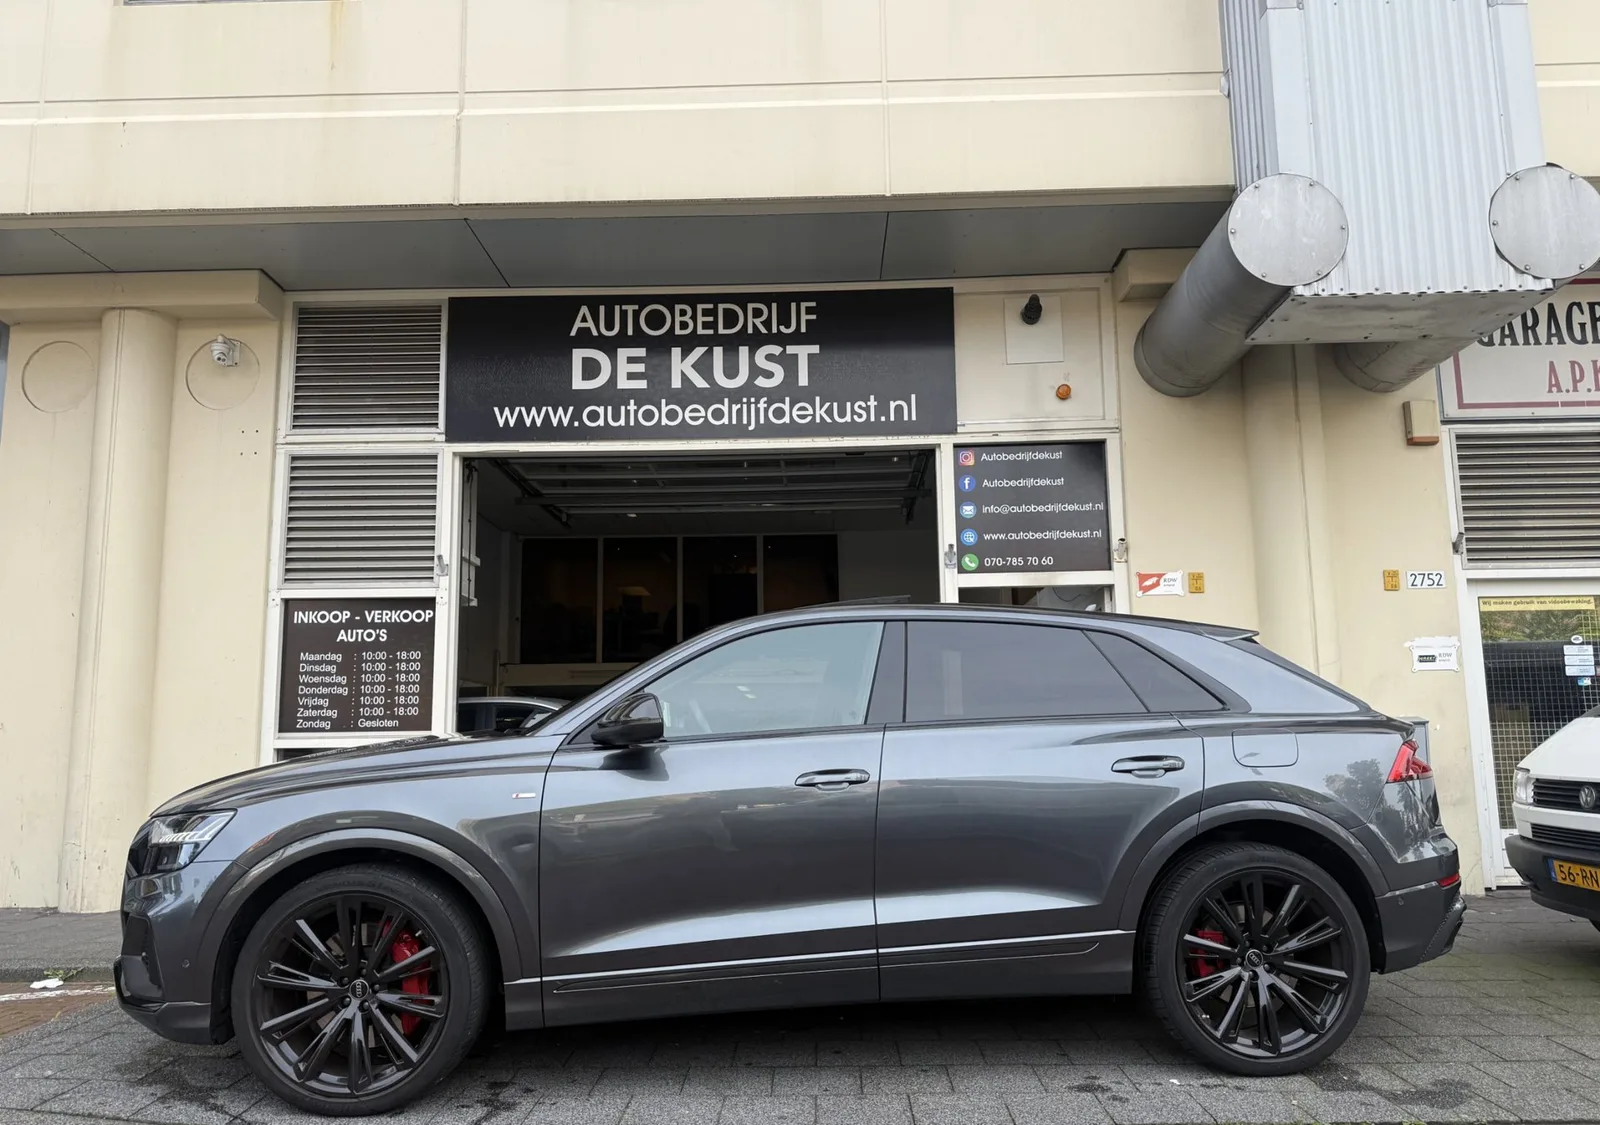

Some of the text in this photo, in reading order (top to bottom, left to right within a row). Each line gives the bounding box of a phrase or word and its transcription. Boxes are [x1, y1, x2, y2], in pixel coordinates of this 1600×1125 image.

[570, 302, 816, 336] AUTOBEDRIJF
[572, 345, 819, 389] DE KUST
[494, 394, 916, 430] www.autobedrijfdekust.nl
[981, 451, 1062, 461] Autobedrijfdekust
[982, 477, 1064, 488] Autobedrijfdekust
[983, 502, 1103, 514] info@autobedrijfdekust.nl
[983, 529, 1101, 540] www.autobedrijfdekust.nl
[984, 557, 1053, 566] 070-785 70 60
[1409, 572, 1443, 587] 2752
[294, 611, 350, 623] INKOOP
[364, 609, 434, 623] VERKOOP
[337, 629, 387, 642] AUTO'S
[300, 652, 342, 662] Maandag
[362, 651, 387, 660] 10:00
[396, 651, 421, 659] 18:00
[299, 663, 337, 673] Dinsdag
[362, 662, 386, 671] 10:00
[396, 662, 420, 671] 18:00
[298, 675, 347, 685] Woensdag
[361, 674, 386, 682] 10:00
[396, 673, 420, 682] 18:00
[298, 685, 348, 696] Donderdag
[361, 685, 385, 693] 10:00
[395, 684, 419, 693] 18:00
[297, 697, 329, 707] Vrijdag
[360, 696, 384, 705] 10:00
[394, 696, 419, 704] 18:00
[296, 708, 338, 718] Zaterdag
[359, 707, 384, 716] 10:00
[394, 707, 418, 715] 18:00
[296, 719, 331, 729] Zondag
[358, 719, 398, 727] Gesloten
